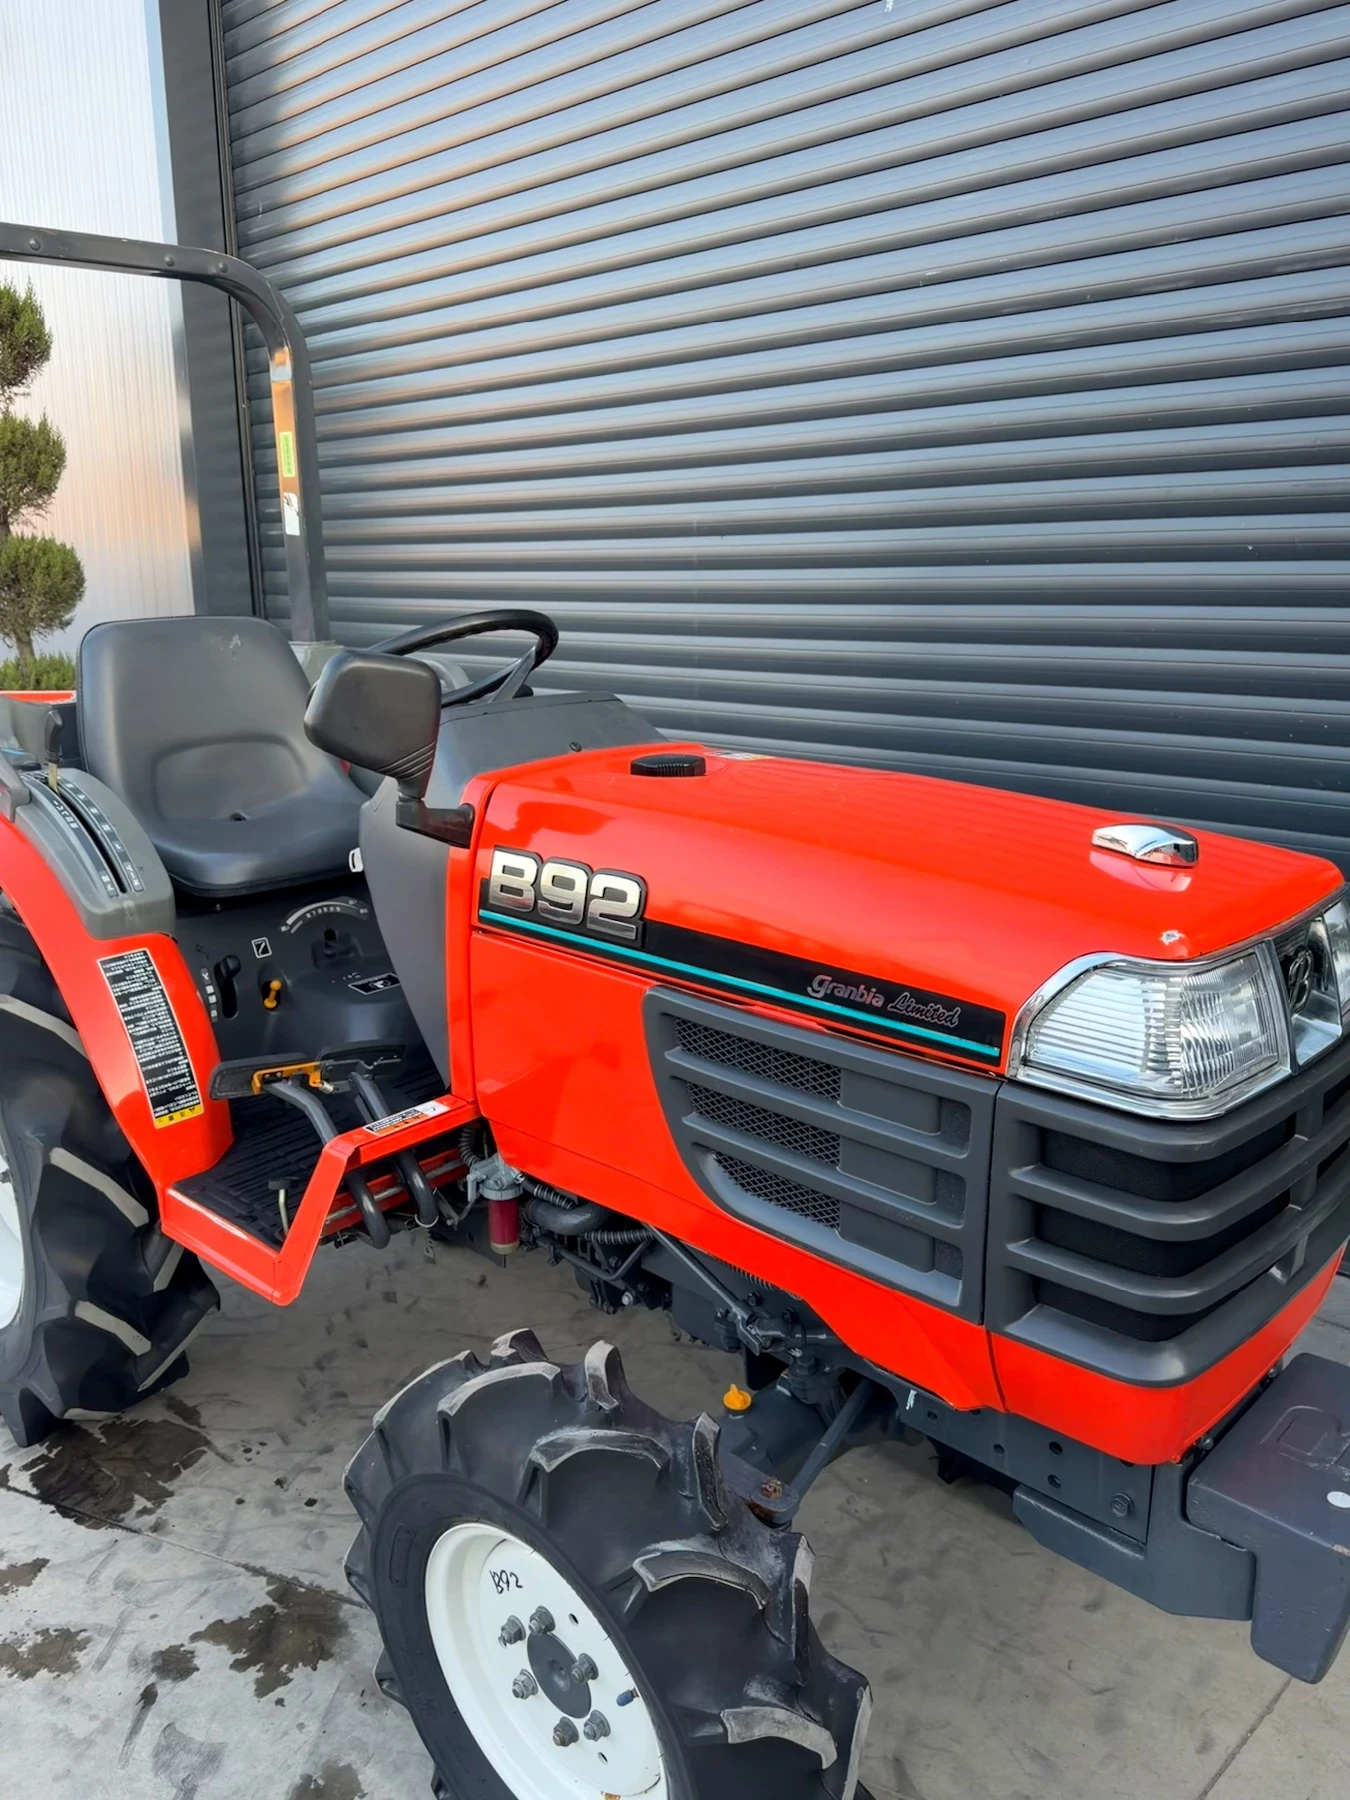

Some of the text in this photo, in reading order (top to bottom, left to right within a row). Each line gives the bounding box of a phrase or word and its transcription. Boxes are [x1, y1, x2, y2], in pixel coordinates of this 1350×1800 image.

[488, 848, 642, 941] B92
[806, 974, 961, 1028] Granbia Limited
[488, 1569, 523, 1595] B92
